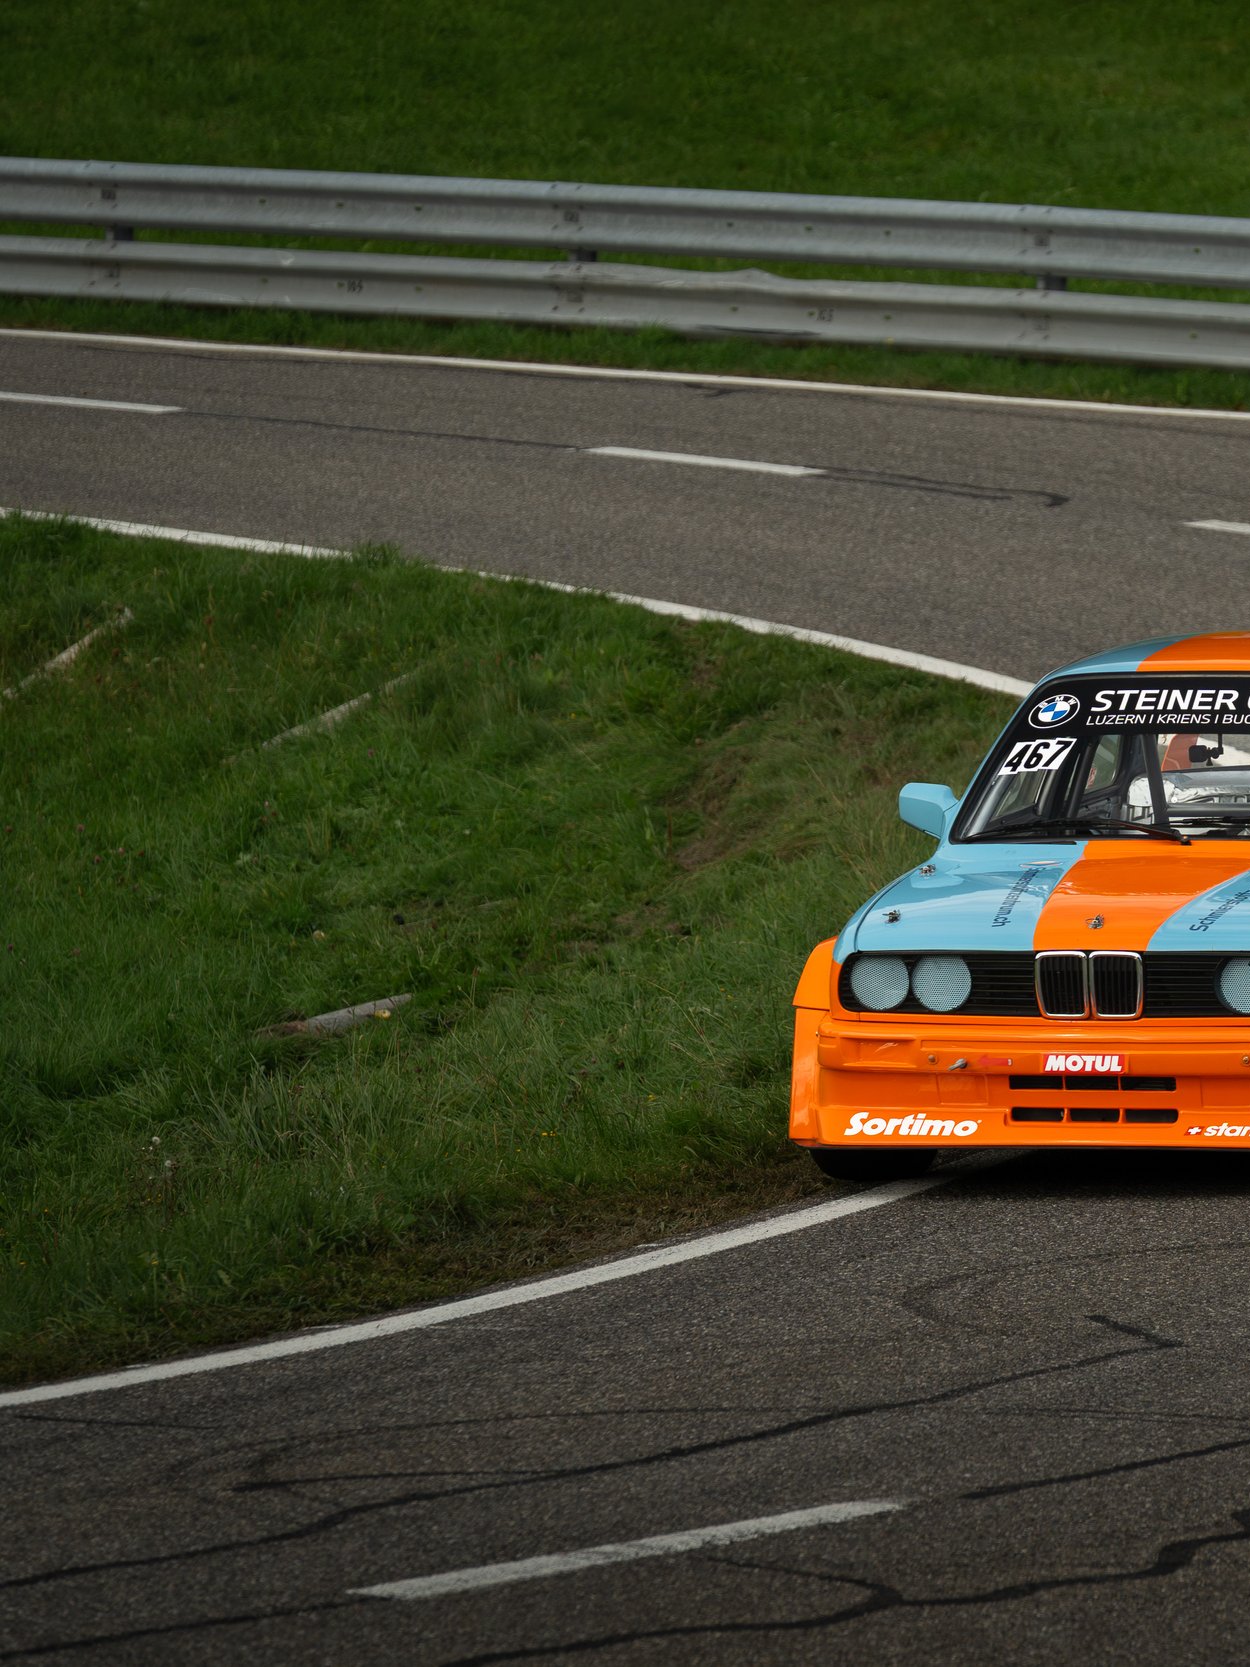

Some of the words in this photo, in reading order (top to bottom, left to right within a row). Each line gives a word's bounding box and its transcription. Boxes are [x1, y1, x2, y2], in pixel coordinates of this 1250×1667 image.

[1090, 689, 1239, 712] STEINER
[1086, 714, 1146, 726] LUZERN
[1157, 713, 1211, 724] KRIENS
[1004, 740, 1074, 772] 467
[1045, 1055, 1122, 1071] MOTUL
[844, 1112, 978, 1136] Sortimo
